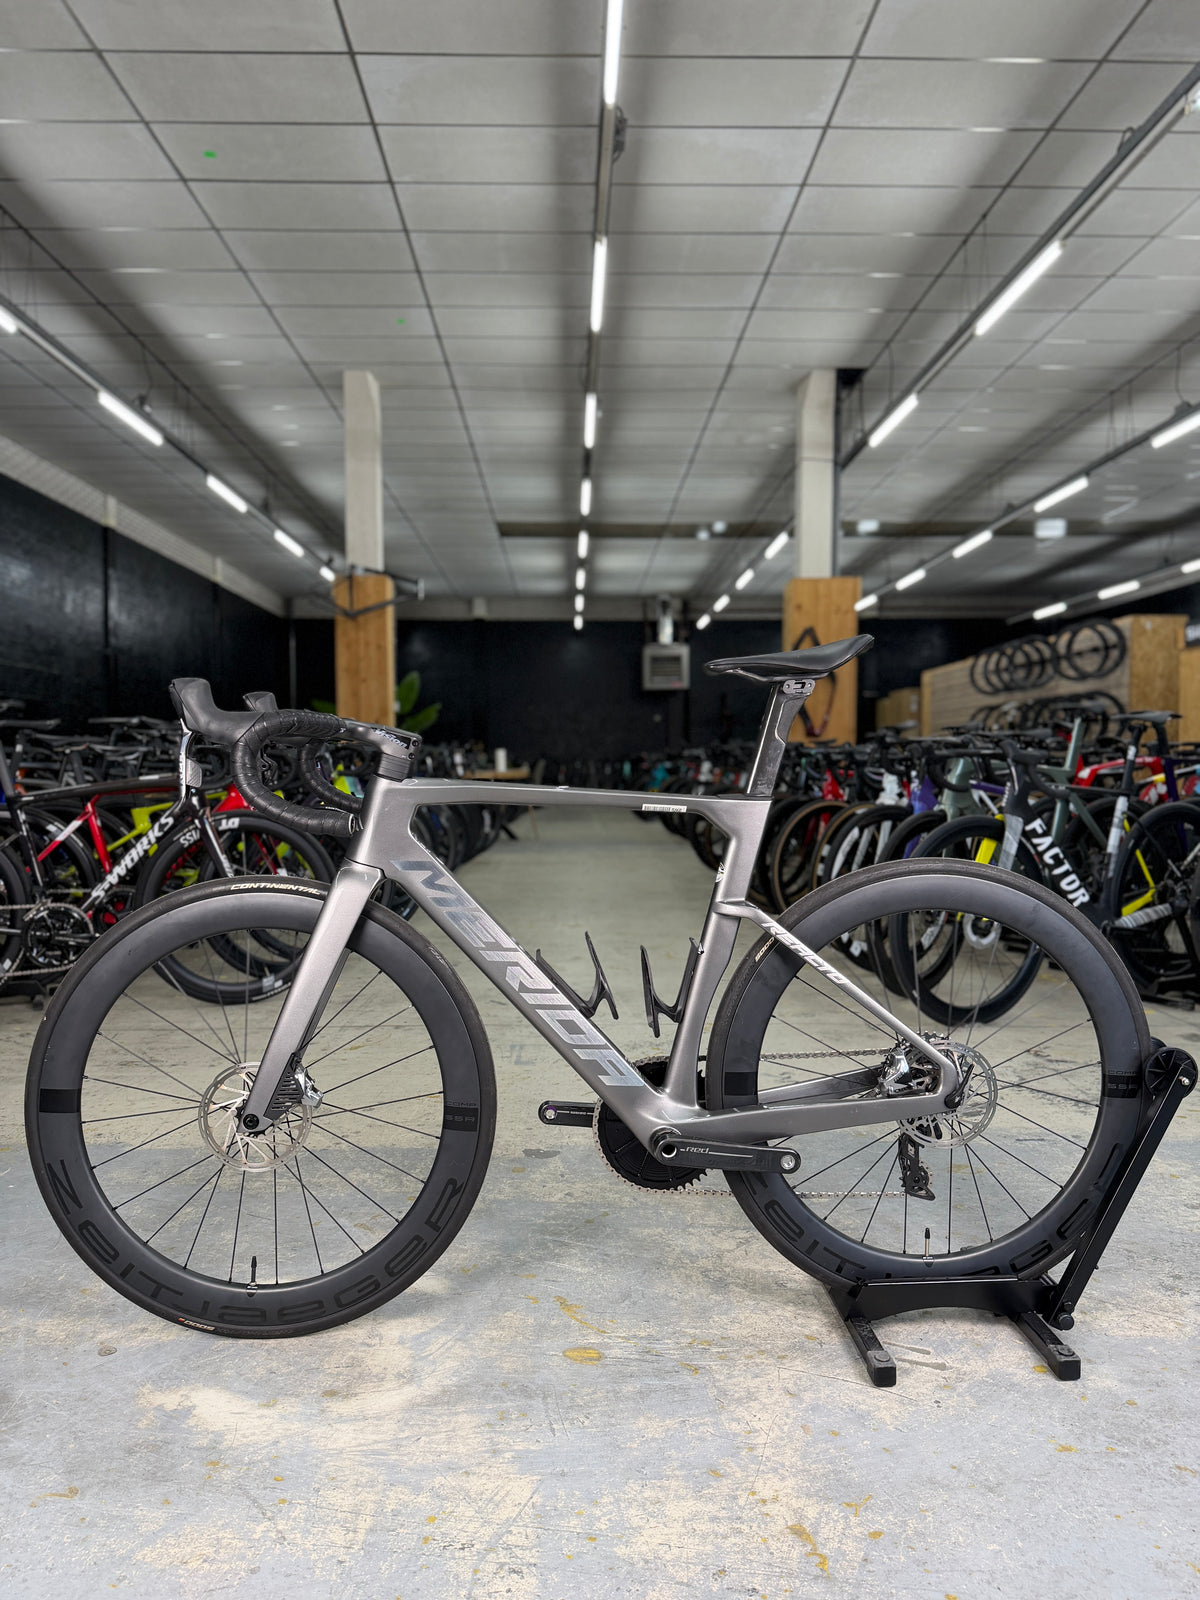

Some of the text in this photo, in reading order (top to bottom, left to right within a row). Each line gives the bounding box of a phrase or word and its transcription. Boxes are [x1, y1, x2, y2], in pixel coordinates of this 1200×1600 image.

[230, 882, 321, 895] CONTINENTAL
[1024, 817, 1091, 907] FACTOR
[390, 860, 645, 1087] MERIDA
[761, 921, 849, 985] REACTO
